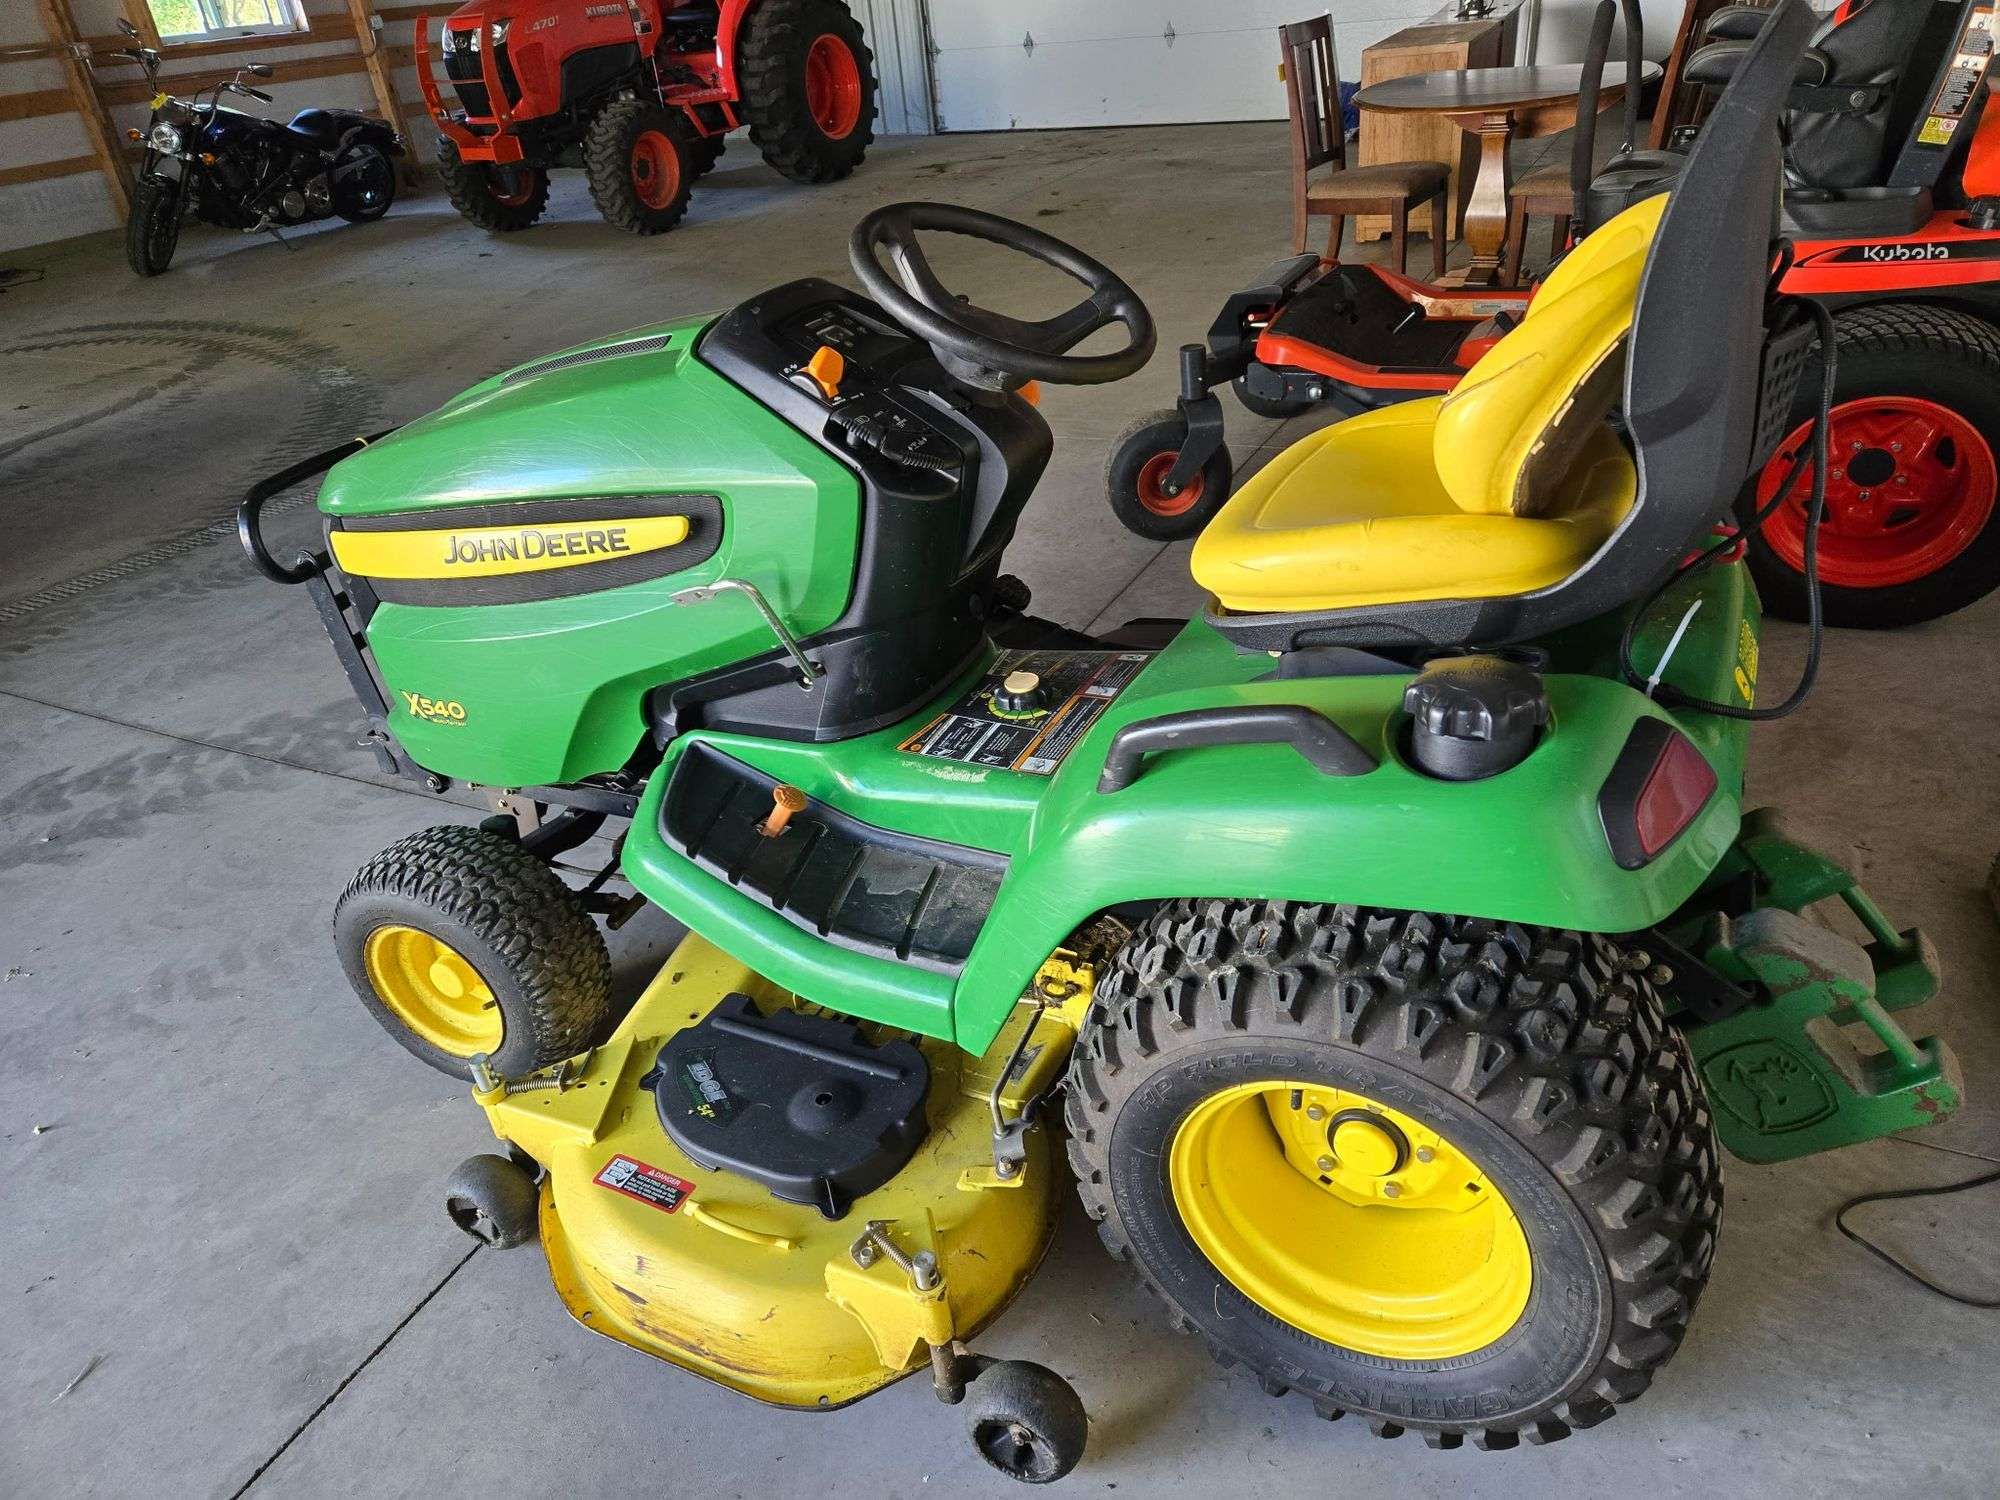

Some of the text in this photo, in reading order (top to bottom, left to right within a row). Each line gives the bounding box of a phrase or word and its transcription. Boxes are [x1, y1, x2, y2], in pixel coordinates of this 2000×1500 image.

[585, 3, 624, 17] KUBOTA
[1863, 243, 1949, 261] Kubota
[444, 528, 630, 564] JOHN DEERE
[400, 690, 467, 720] X540
[654, 1171, 681, 1186] DANGER
